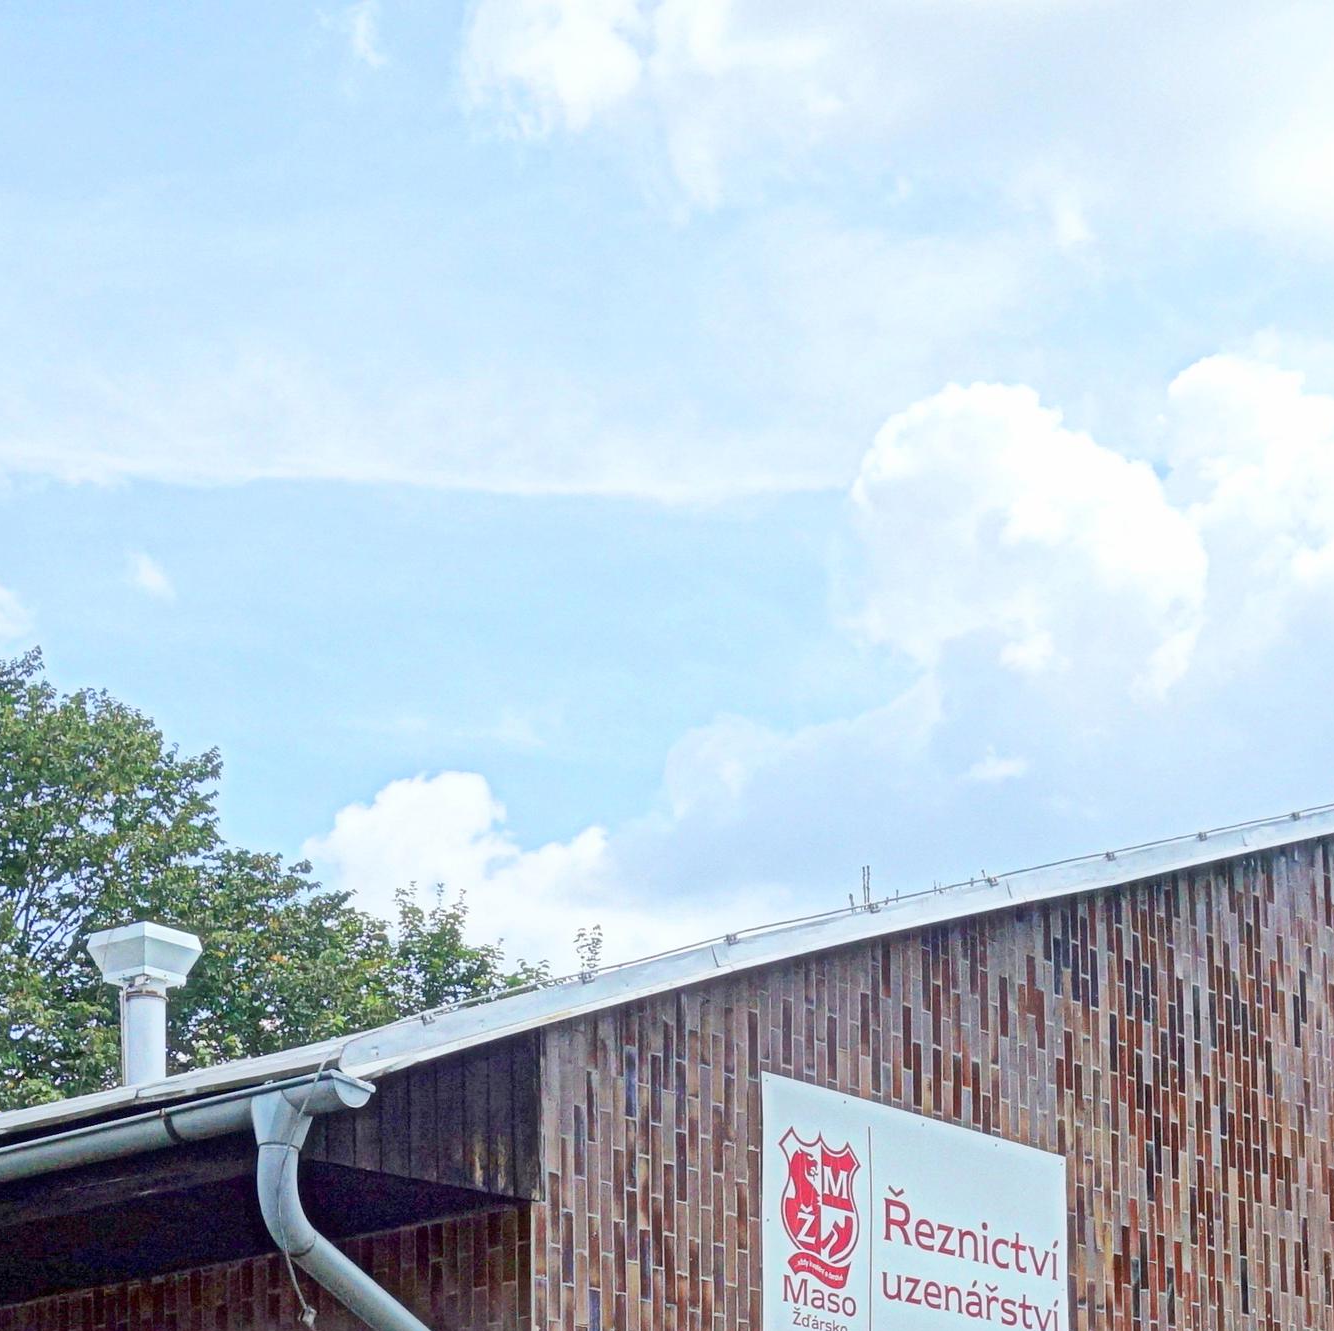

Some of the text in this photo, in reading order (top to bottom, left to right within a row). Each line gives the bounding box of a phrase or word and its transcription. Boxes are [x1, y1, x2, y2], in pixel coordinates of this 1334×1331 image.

[823, 1165, 849, 1200] M
[796, 1203, 816, 1244] Ž
[883, 1184, 1060, 1281] Řeznictví
[782, 1274, 857, 1317] Maso
